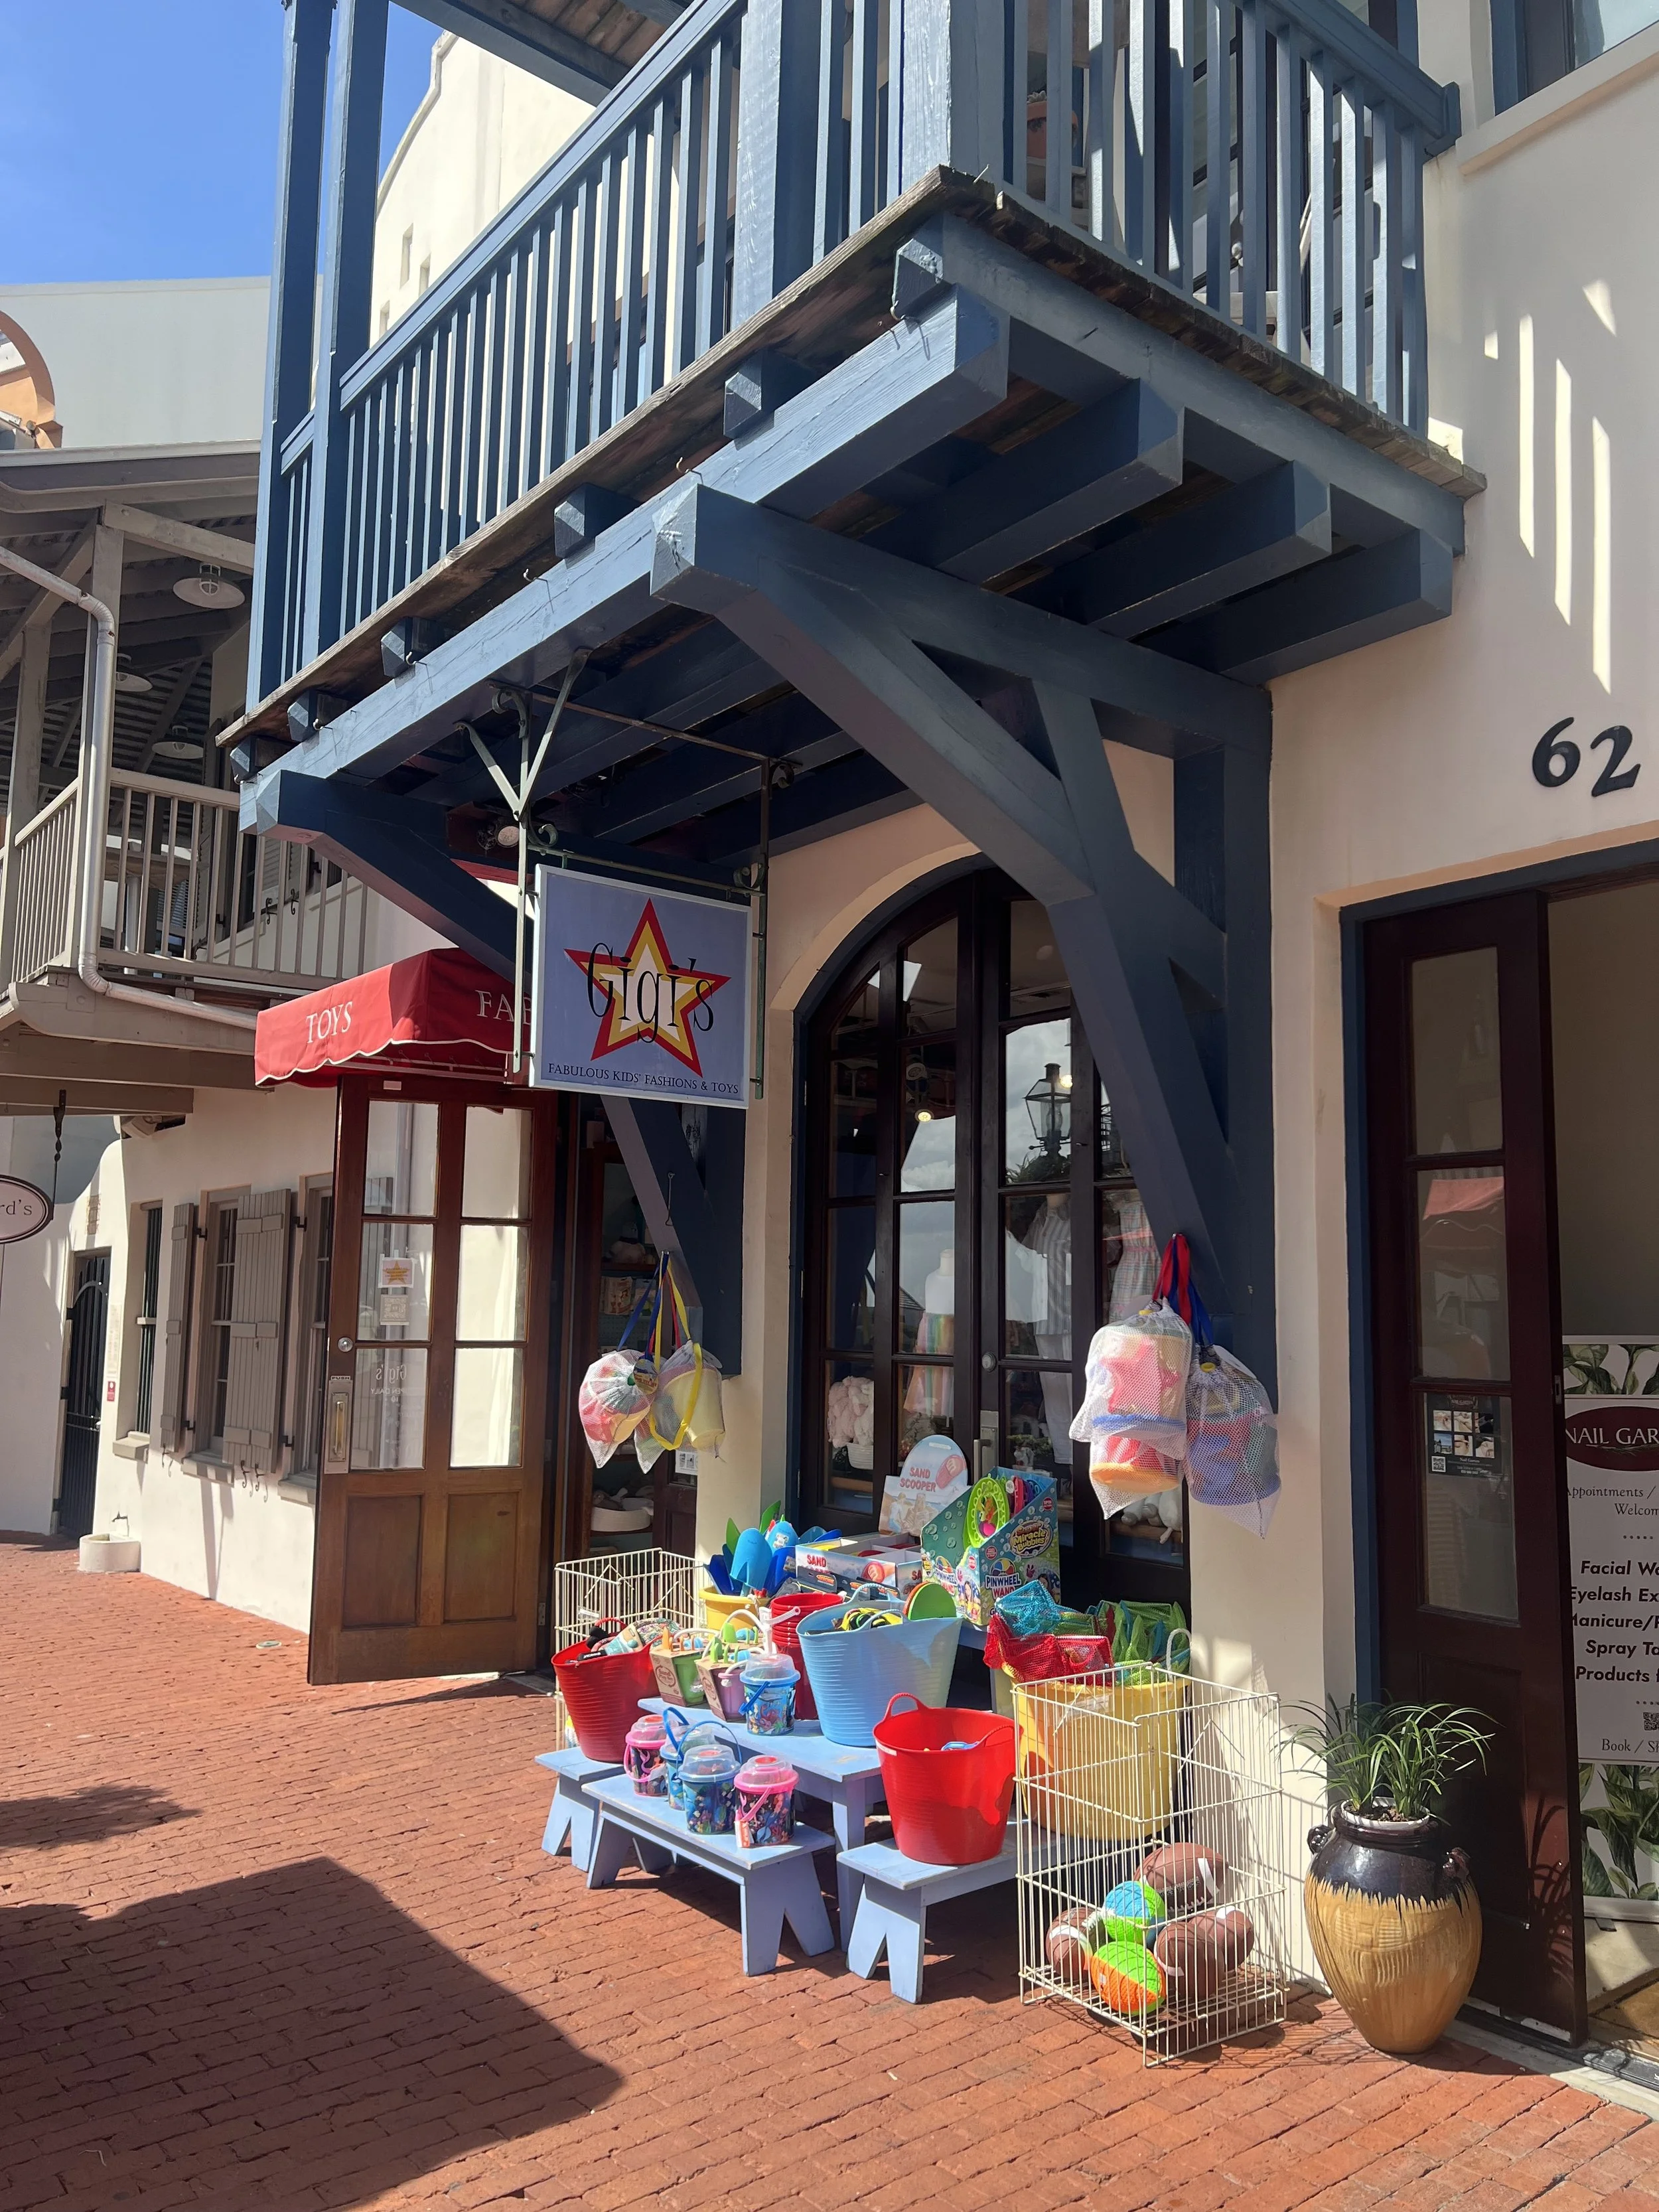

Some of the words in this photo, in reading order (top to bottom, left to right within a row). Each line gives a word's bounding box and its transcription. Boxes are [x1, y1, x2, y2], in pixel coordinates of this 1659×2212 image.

[1532, 717, 1640, 797] 62
[587, 942, 714, 1043] Gigi's
[305, 1001, 353, 1044] TOYS
[548, 1063, 609, 1080] FABULOUS
[613, 1070, 641, 1083] KIDS'
[644, 1074, 697, 1090] FASHIONS
[701, 1082, 708, 1090] &
[711, 1082, 739, 1094] TOYS
[1565, 1428, 1609, 1444] NAIL
[910, 1467, 930, 1479] SAND
[900, 1478, 936, 1492] SCOOPER
[1012, 1530, 1046, 1546] Miracle
[1017, 1537, 1045, 1552] Bubbles
[807, 1554, 827, 1568] SAND
[1581, 1560, 1631, 1575] Facial
[986, 1574, 1021, 1587] PINWHEEL
[1638, 1588, 1659, 1602] Ex
[1585, 1639, 1637, 1659] Spray
[1575, 1666, 1650, 1682] Products
[1602, 1738, 1631, 1751] Book
